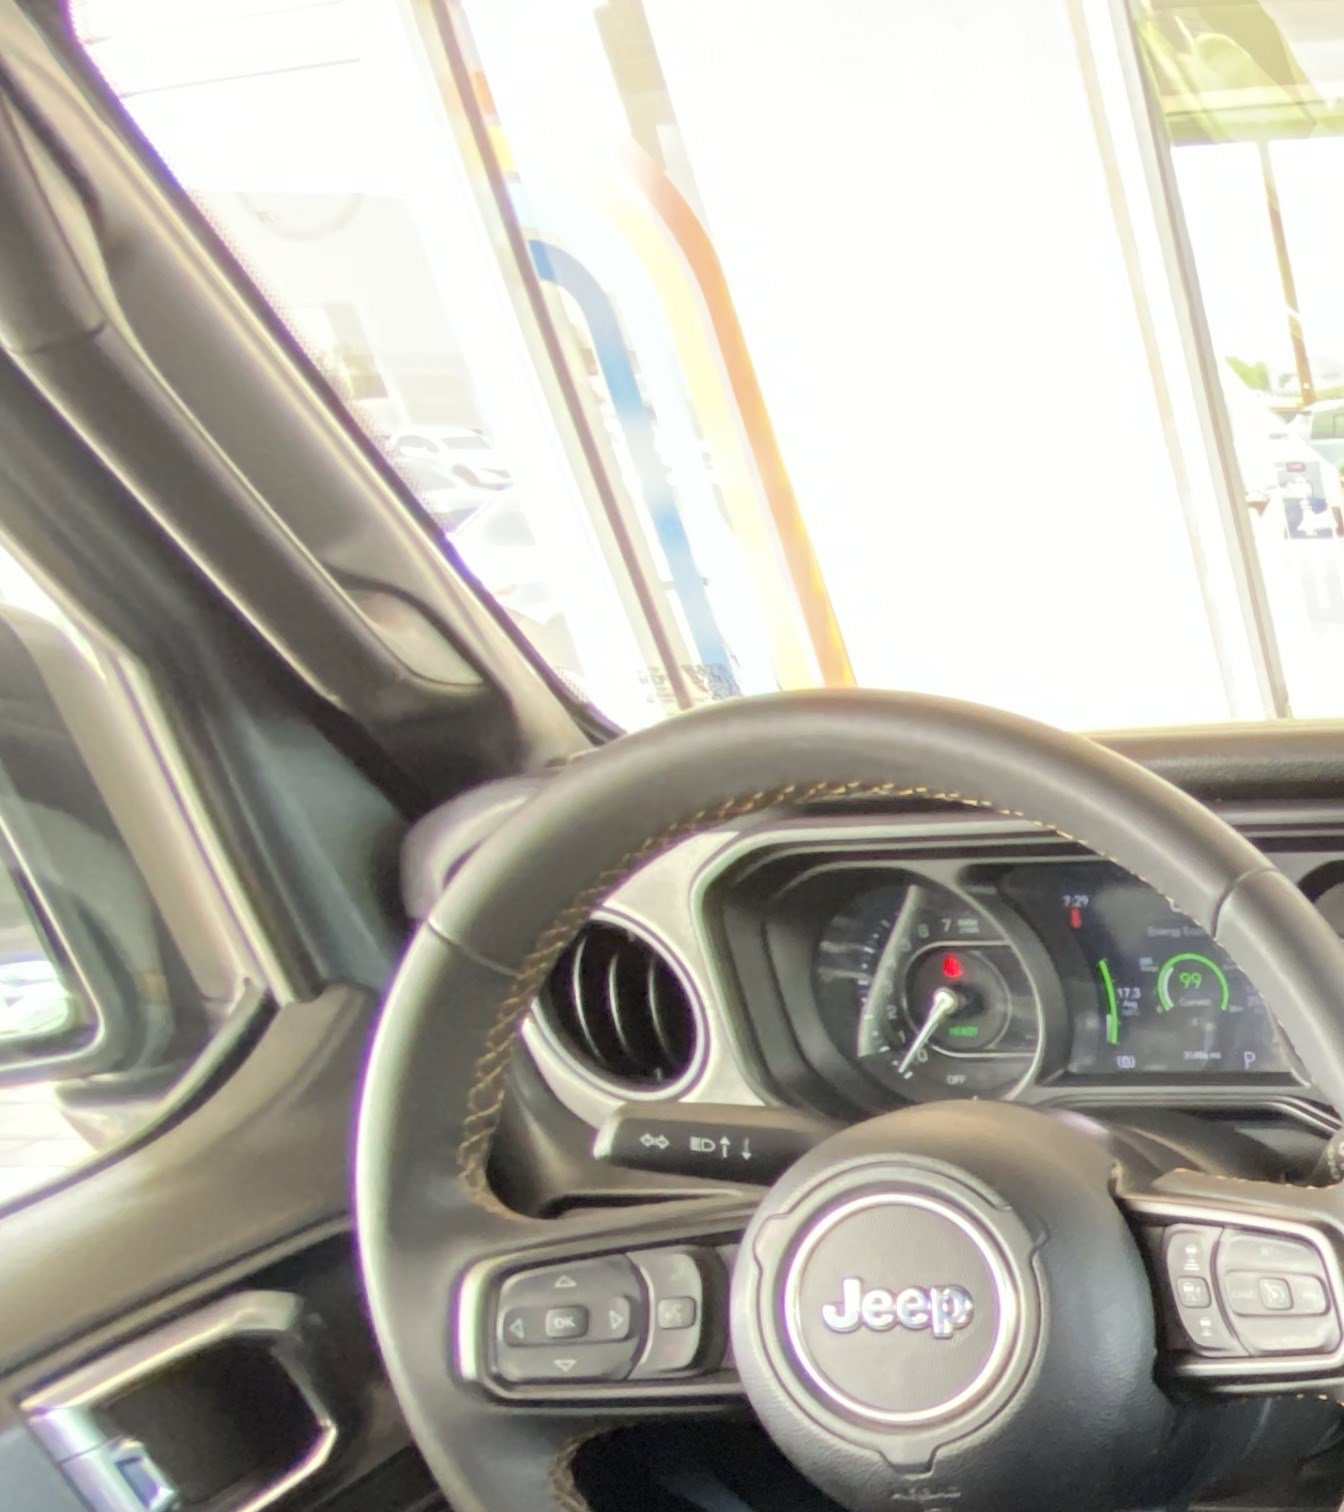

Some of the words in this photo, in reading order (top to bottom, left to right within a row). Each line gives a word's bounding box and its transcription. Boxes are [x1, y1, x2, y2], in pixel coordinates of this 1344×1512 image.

[1180, 972, 1202, 988] 99
[1243, 1051, 1256, 1070] P
[822, 1275, 975, 1340] Jeep
[553, 1316, 575, 1330] OK
